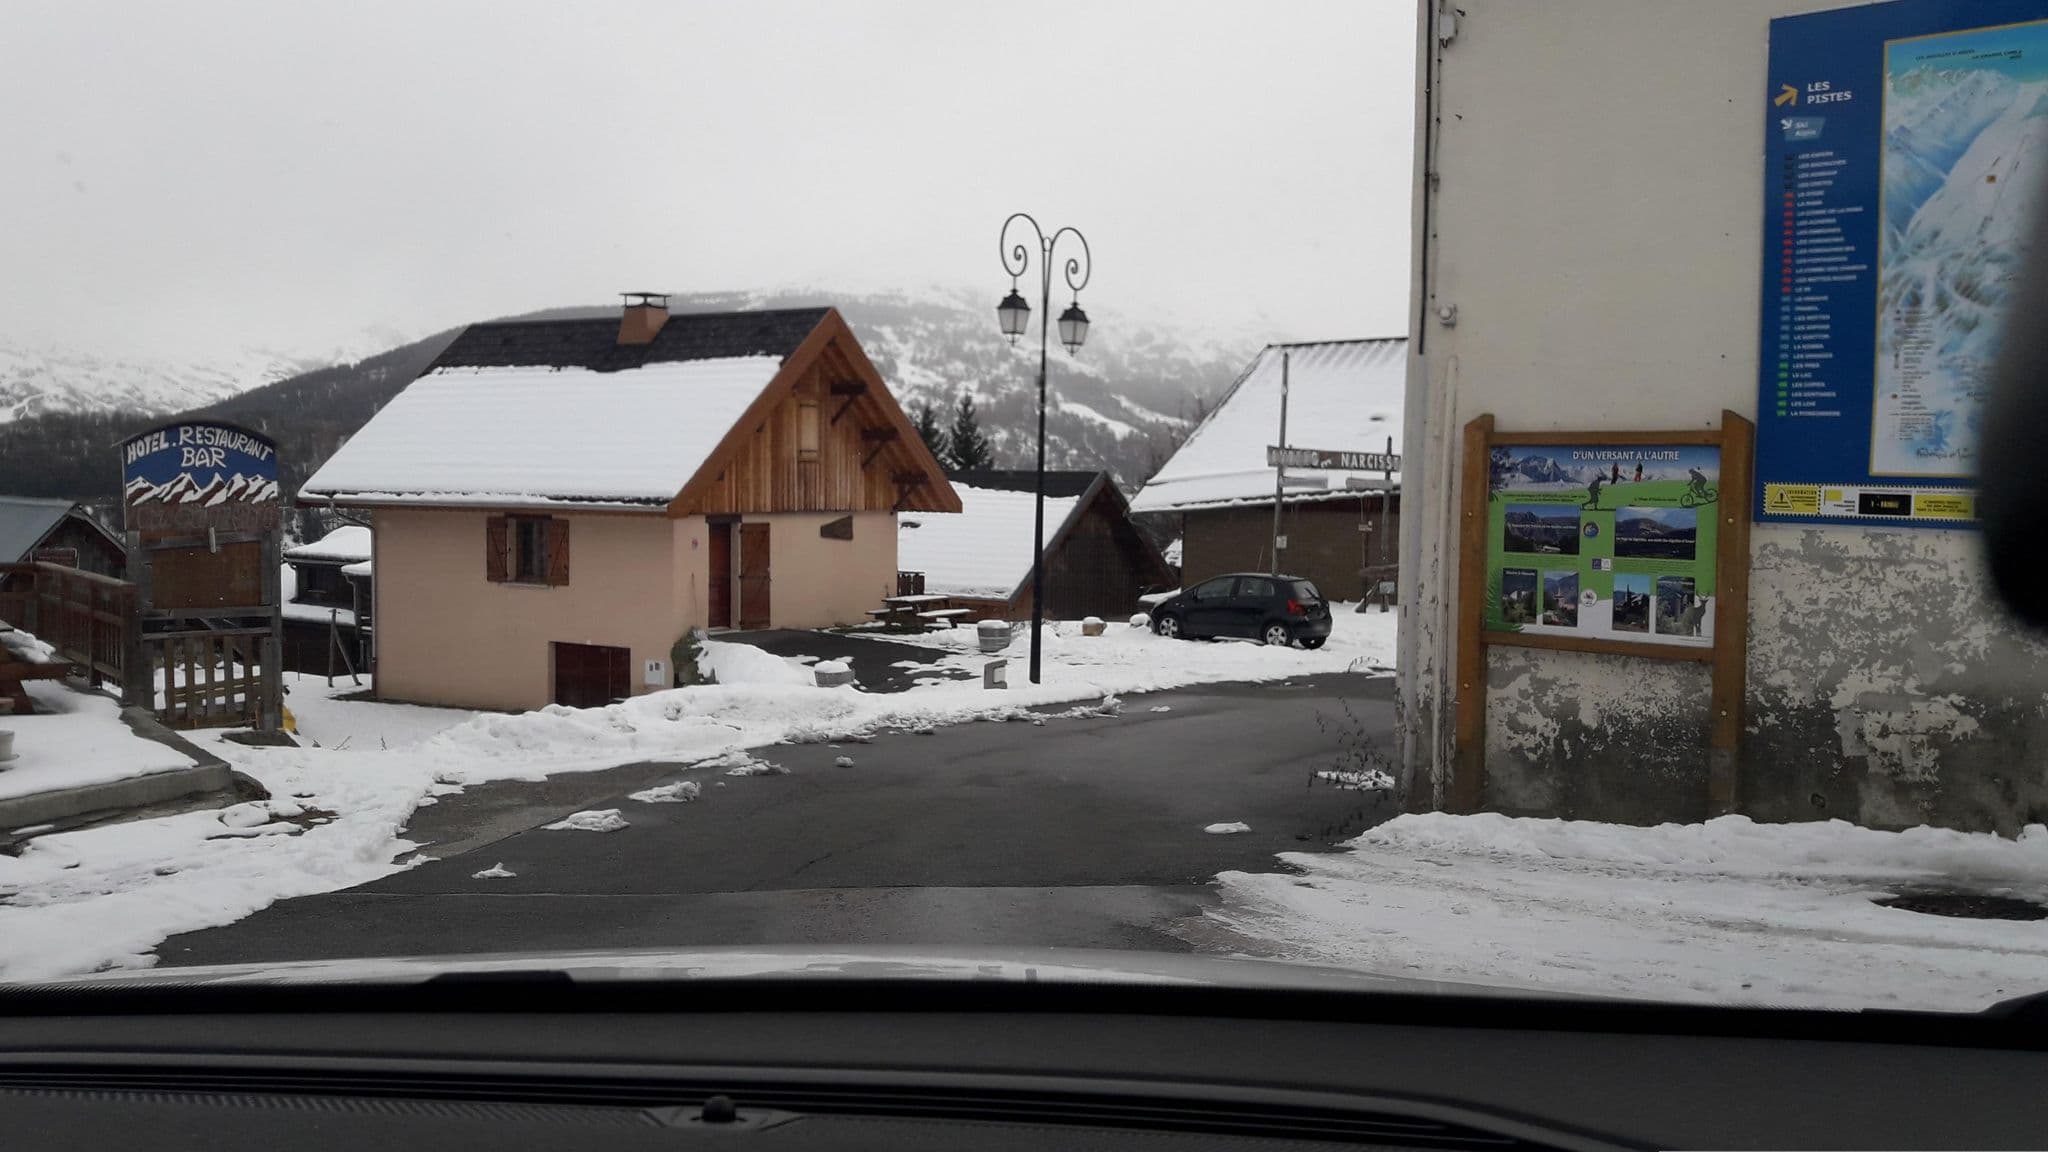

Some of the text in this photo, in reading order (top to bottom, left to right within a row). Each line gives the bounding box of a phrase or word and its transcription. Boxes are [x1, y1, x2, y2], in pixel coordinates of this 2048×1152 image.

[1807, 81, 1830, 92] LES
[1807, 91, 1852, 104] PISTES
[127, 426, 274, 464] HOTEL RESTAURANT
[181, 447, 227, 468] BAR
[1573, 450, 1595, 461] D'UN
[1596, 450, 1635, 461] VERSANT
[1644, 450, 1680, 461] L'AUTRE
